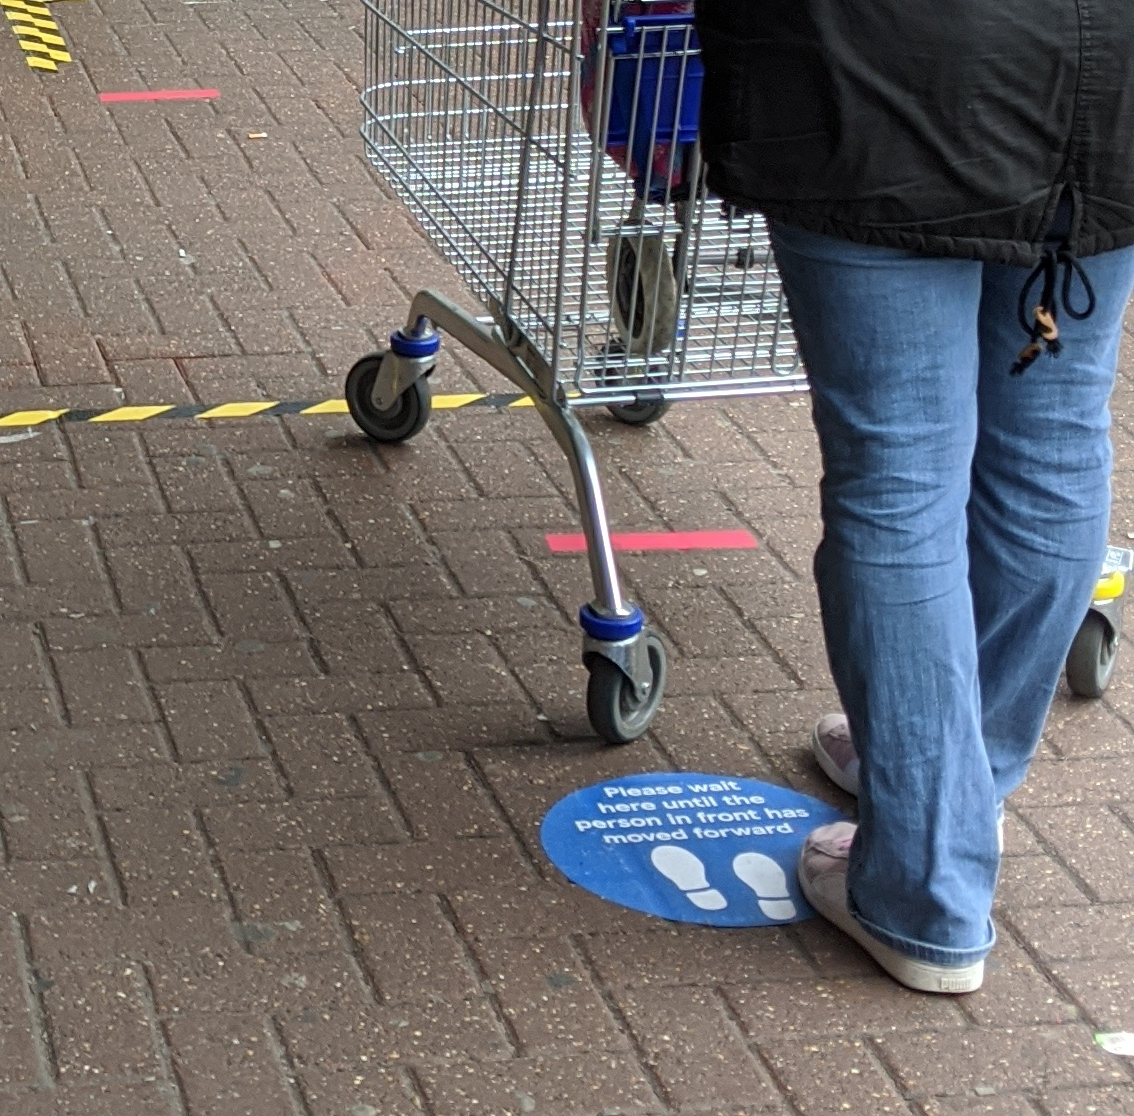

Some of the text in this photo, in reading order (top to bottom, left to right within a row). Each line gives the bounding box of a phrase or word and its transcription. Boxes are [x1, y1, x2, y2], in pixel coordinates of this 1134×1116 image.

[603, 780, 742, 799] Please wait
[597, 794, 765, 815] here until the
[575, 807, 810, 831] person in front has
[603, 822, 794, 844] moved forward
